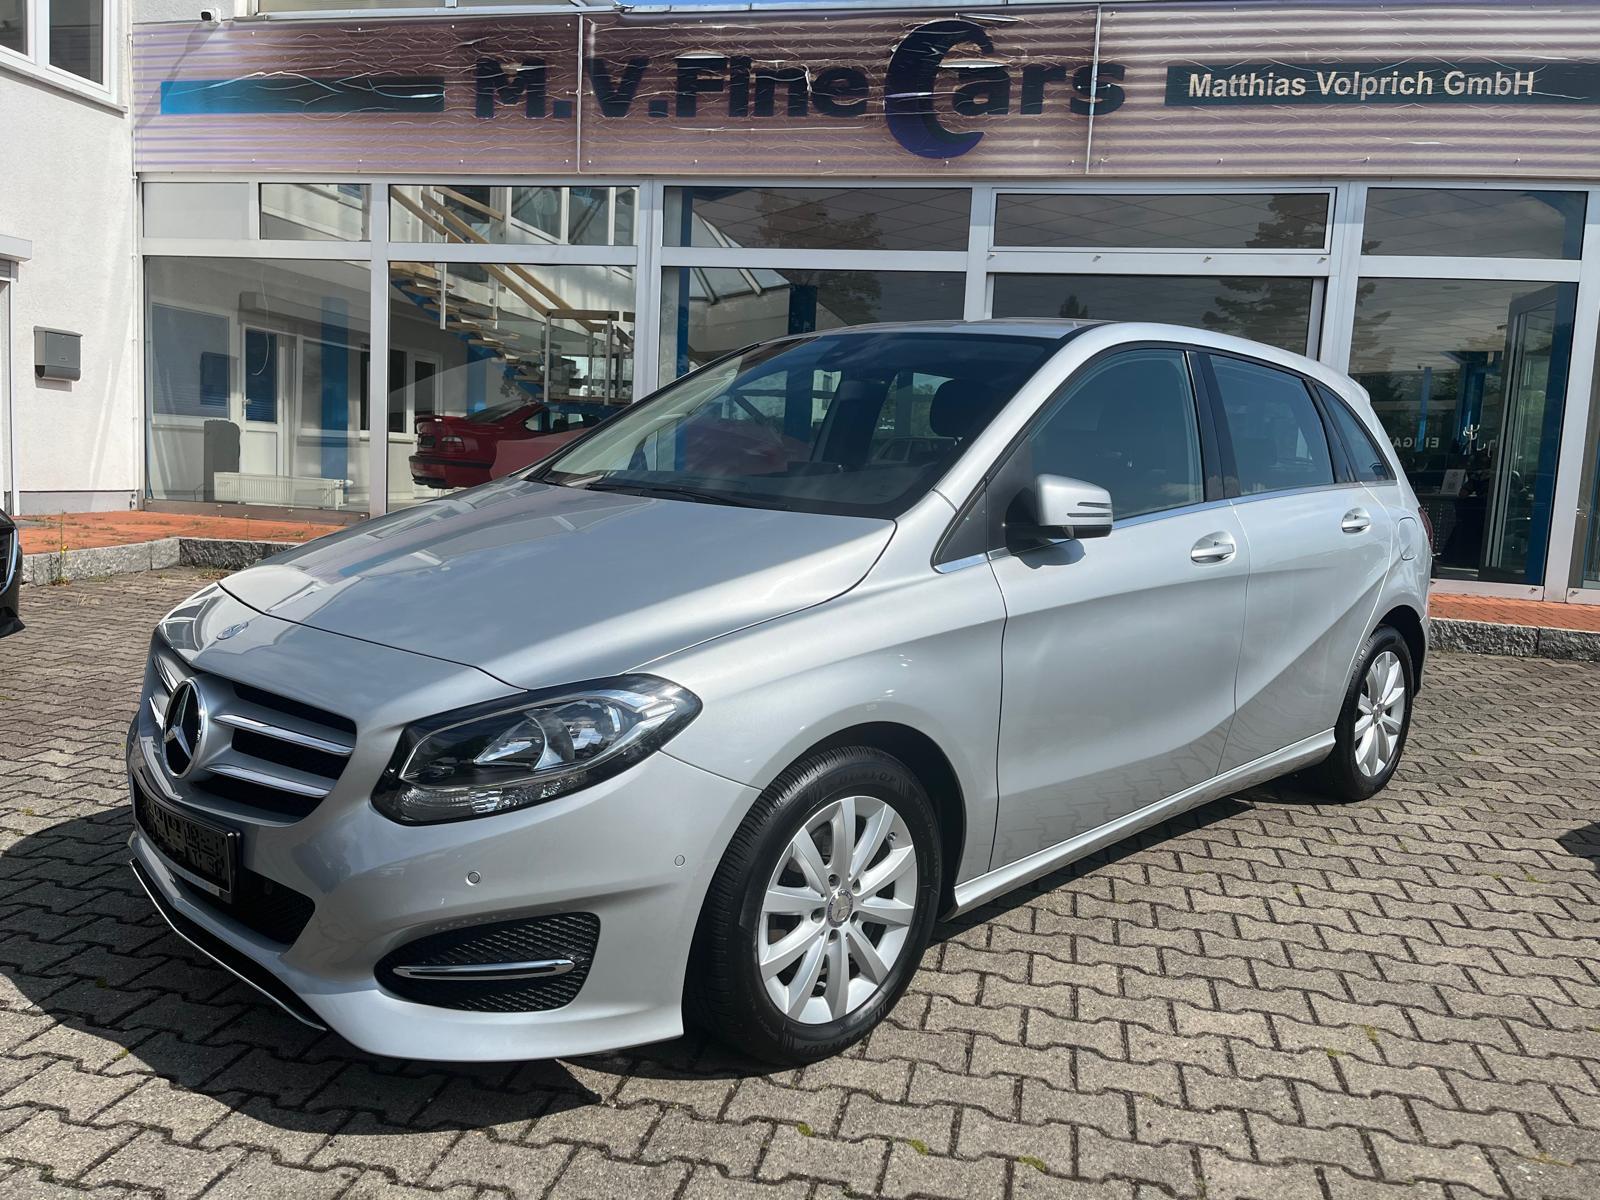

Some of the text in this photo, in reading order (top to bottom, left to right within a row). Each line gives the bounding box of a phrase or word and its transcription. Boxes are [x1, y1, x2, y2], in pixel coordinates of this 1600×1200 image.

[1189, 70, 1534, 100] Matthias Volprich GmbH
